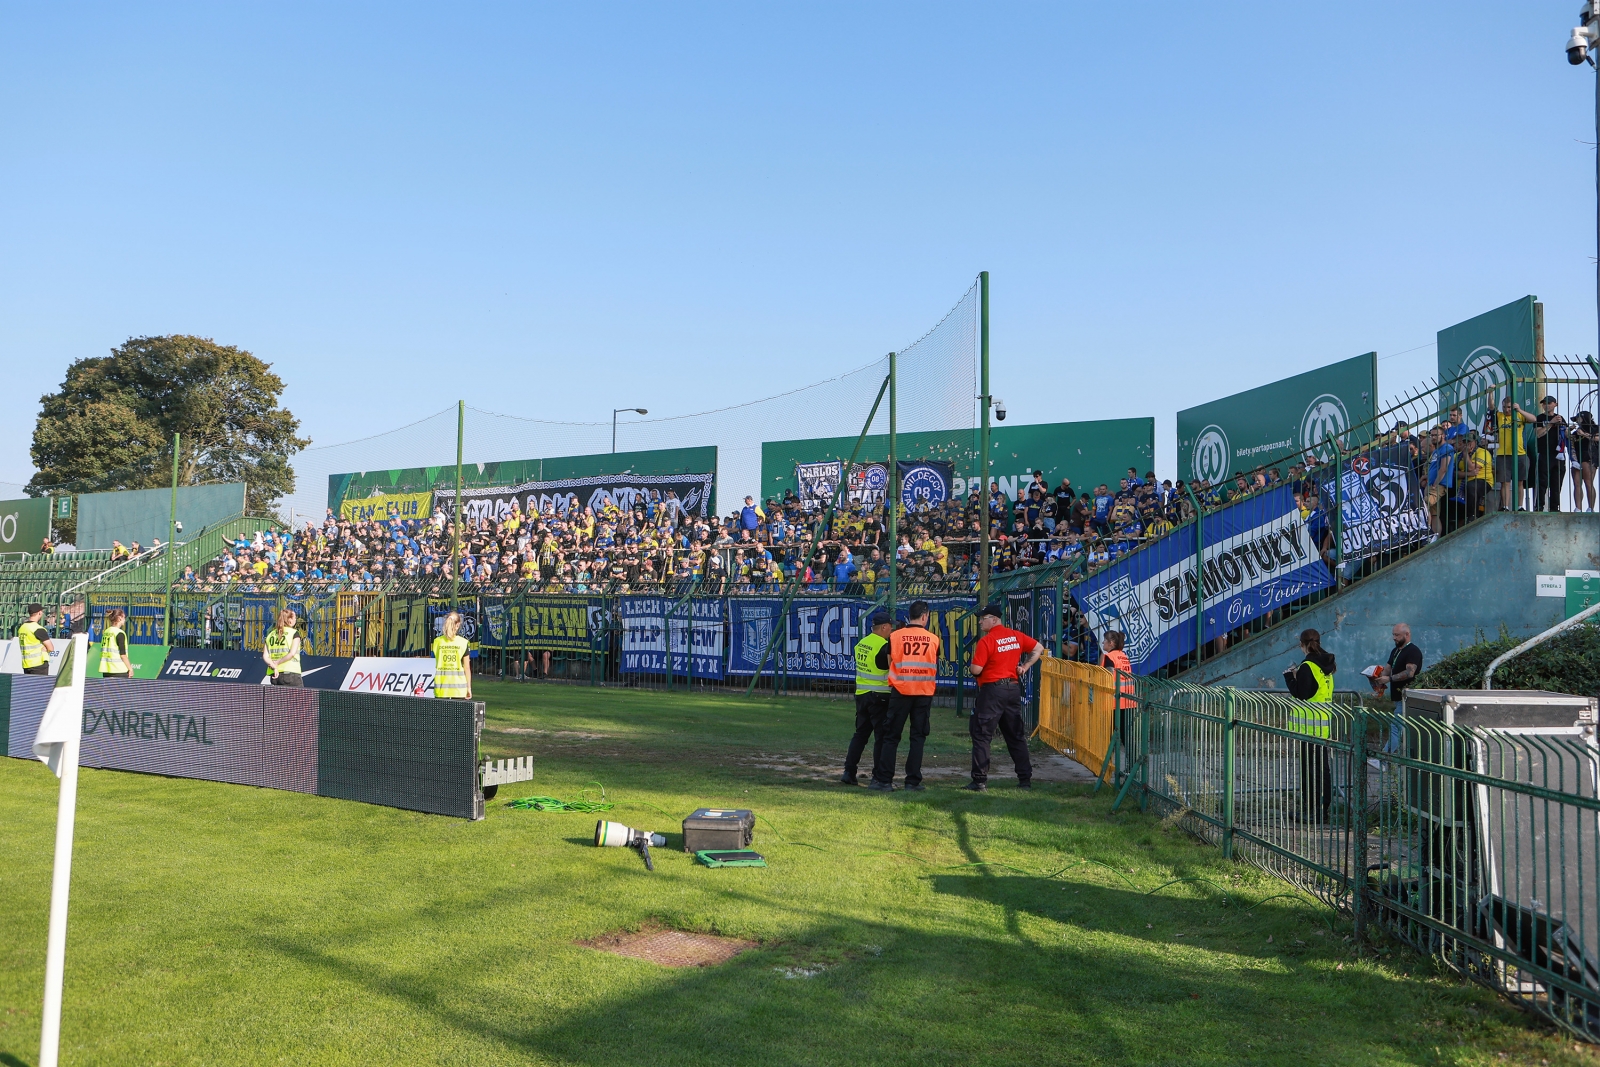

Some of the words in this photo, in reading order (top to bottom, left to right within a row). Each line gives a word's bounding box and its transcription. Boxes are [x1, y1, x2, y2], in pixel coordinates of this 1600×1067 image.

[1236, 437, 1292, 457] bilety.wartapoznan.pl
[800, 466, 839, 478] CARLOS
[904, 471, 942, 492] WILDECCY
[61, 501, 68, 513] E
[1152, 520, 1307, 622] SZAMOTUŁY
[1108, 580, 1129, 597] LECH
[625, 600, 661, 615] LECH
[664, 600, 720, 618] POZNAŃ
[1227, 597, 1254, 624] On
[509, 605, 587, 638] TCZEW
[783, 606, 867, 656] LECH
[629, 625, 661, 643] TLP
[903, 641, 930, 656] 027
[443, 655, 457, 663] 098
[625, 653, 718, 674] WOLSZTYN
